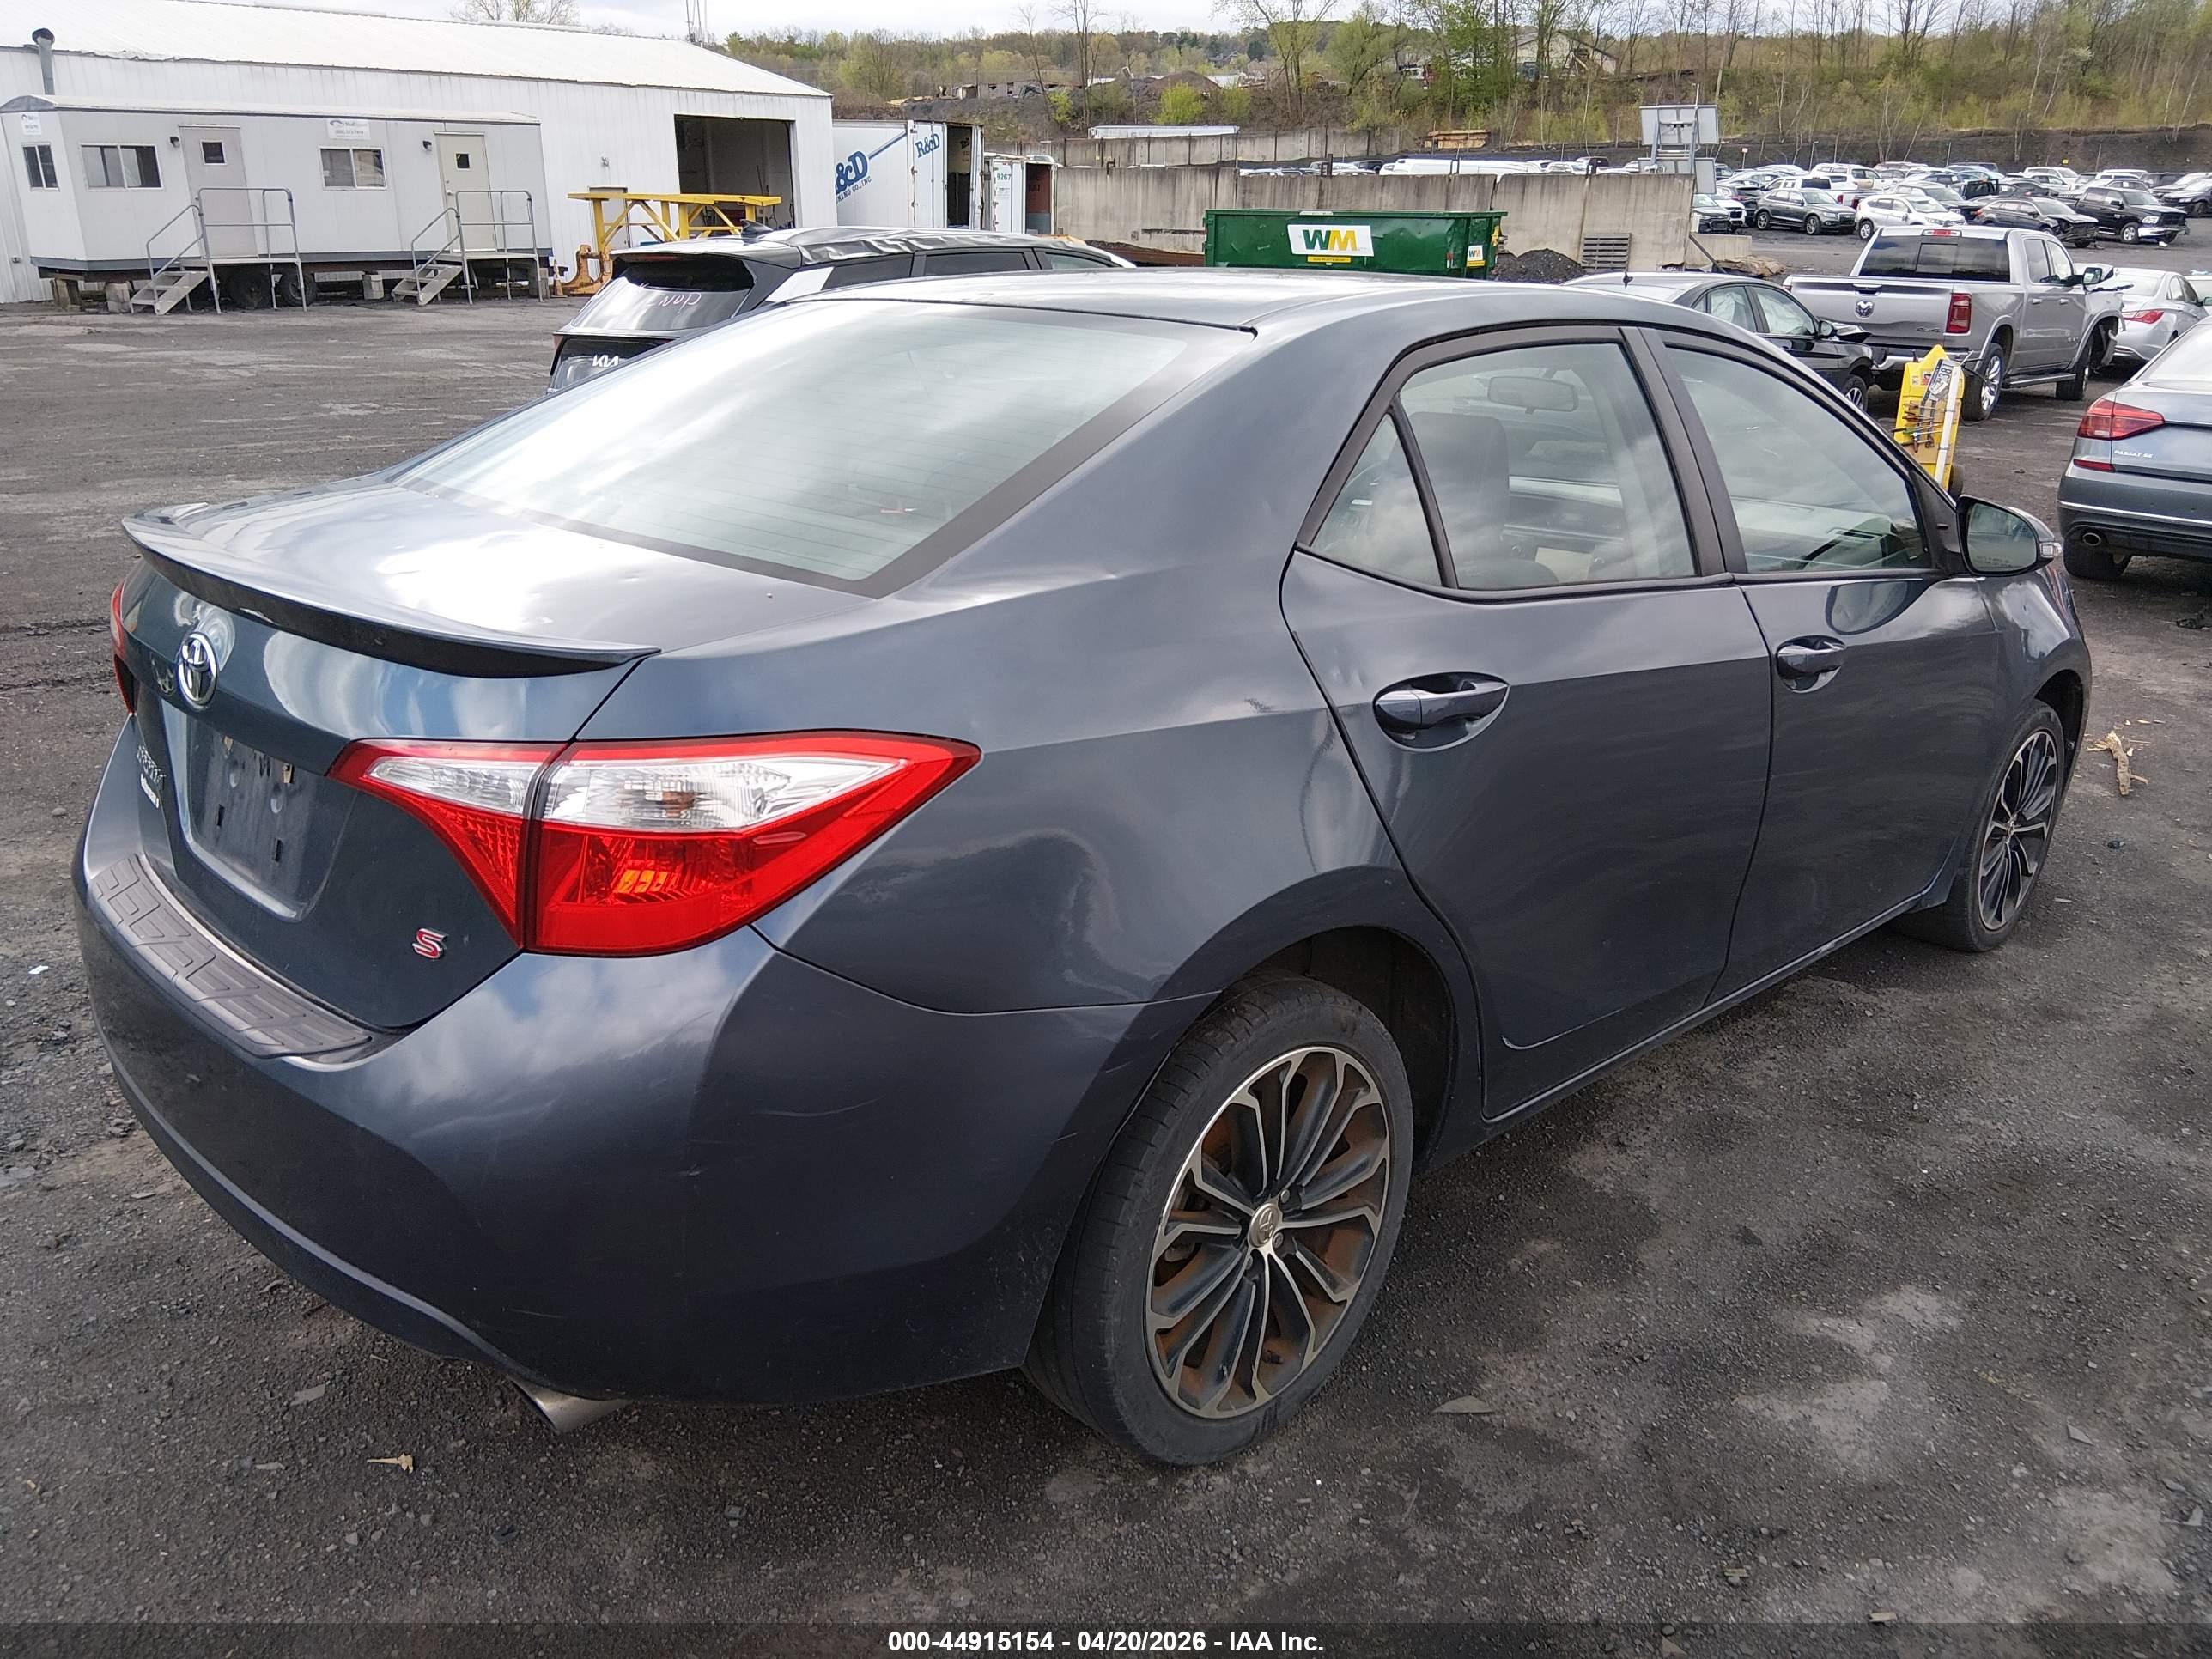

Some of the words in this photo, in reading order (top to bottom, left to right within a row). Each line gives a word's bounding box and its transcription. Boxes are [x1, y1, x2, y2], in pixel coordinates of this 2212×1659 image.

[915, 133, 940, 158] R&D
[836, 150, 867, 195] &D
[1303, 229, 1357, 251] WM
[412, 927, 447, 959] S
